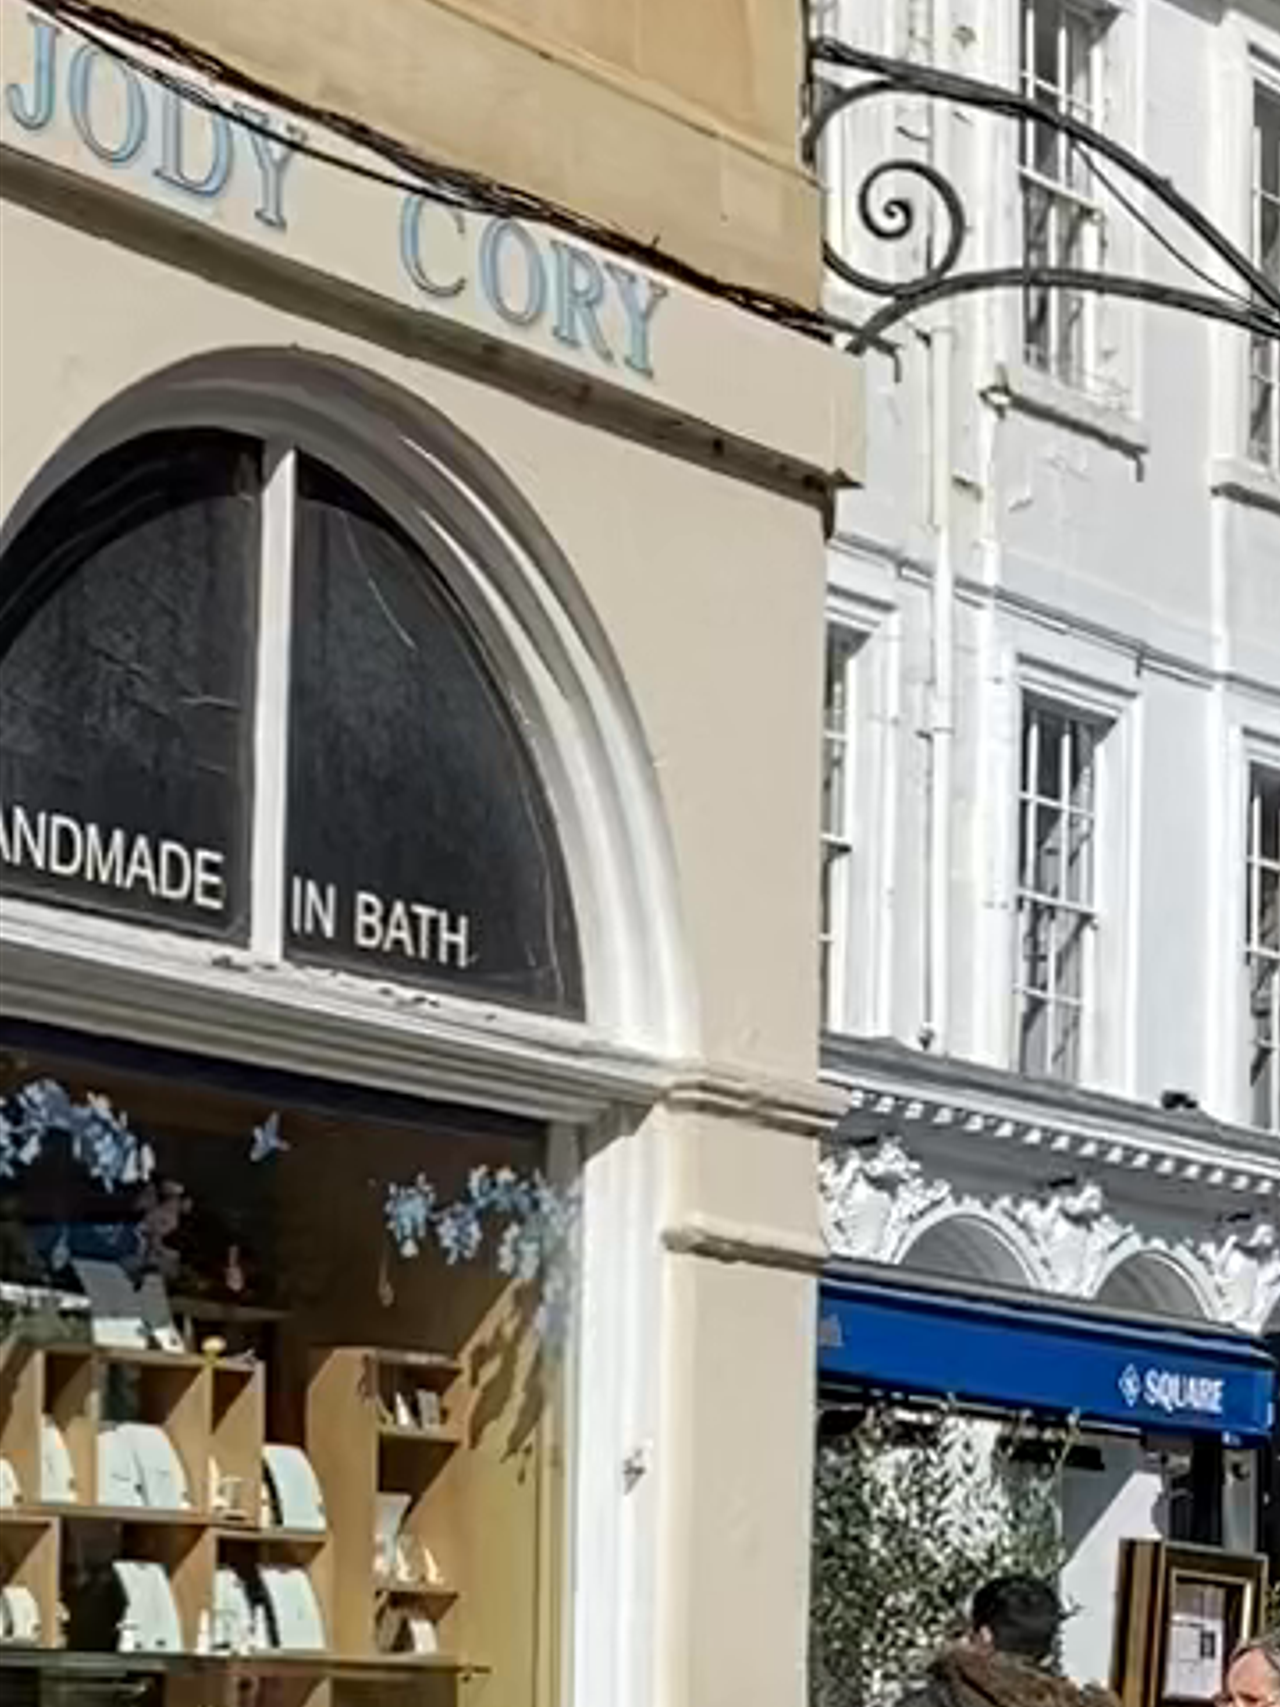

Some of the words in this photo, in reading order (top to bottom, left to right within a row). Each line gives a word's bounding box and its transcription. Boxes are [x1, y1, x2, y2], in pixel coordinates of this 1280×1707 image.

[7, 12, 308, 233] JODY
[398, 191, 669, 380] CORY
[0, 805, 224, 910] NDMADE
[292, 876, 336, 938] IN
[354, 891, 469, 968] BATH
[1144, 1368, 1225, 1413] SQUARE
